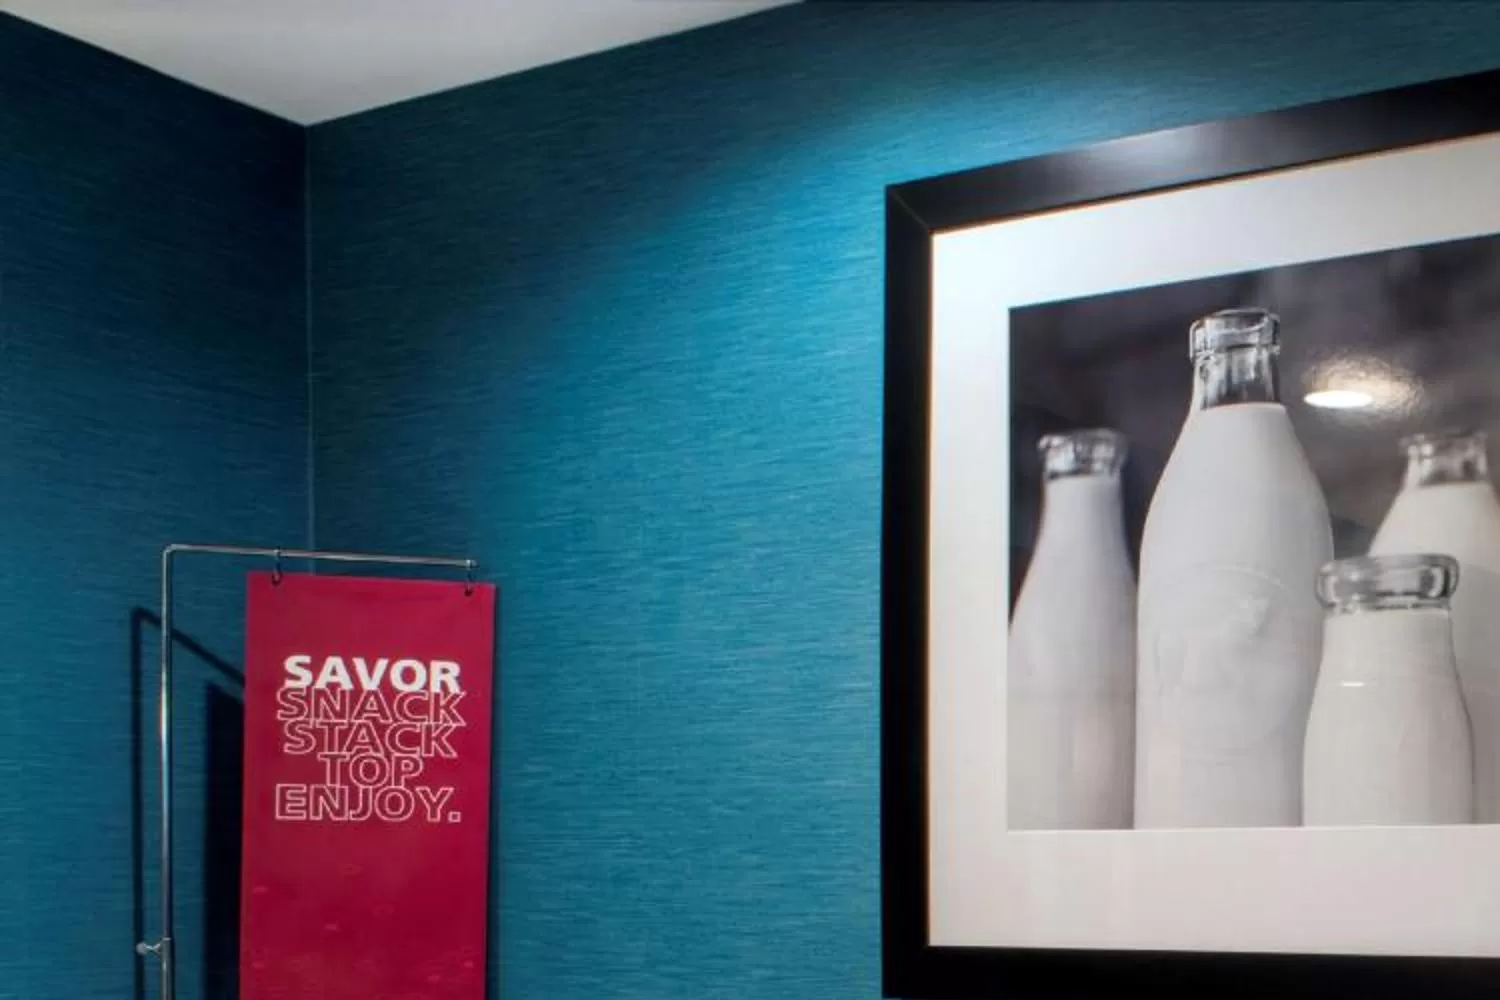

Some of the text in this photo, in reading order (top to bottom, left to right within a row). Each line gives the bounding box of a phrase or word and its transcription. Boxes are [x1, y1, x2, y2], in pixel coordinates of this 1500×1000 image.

[283, 654, 461, 694] SAVOR
[276, 687, 467, 727] SNACK
[283, 719, 458, 759] STACK
[317, 751, 423, 789] TOP
[274, 782, 462, 823] ENJOY.
